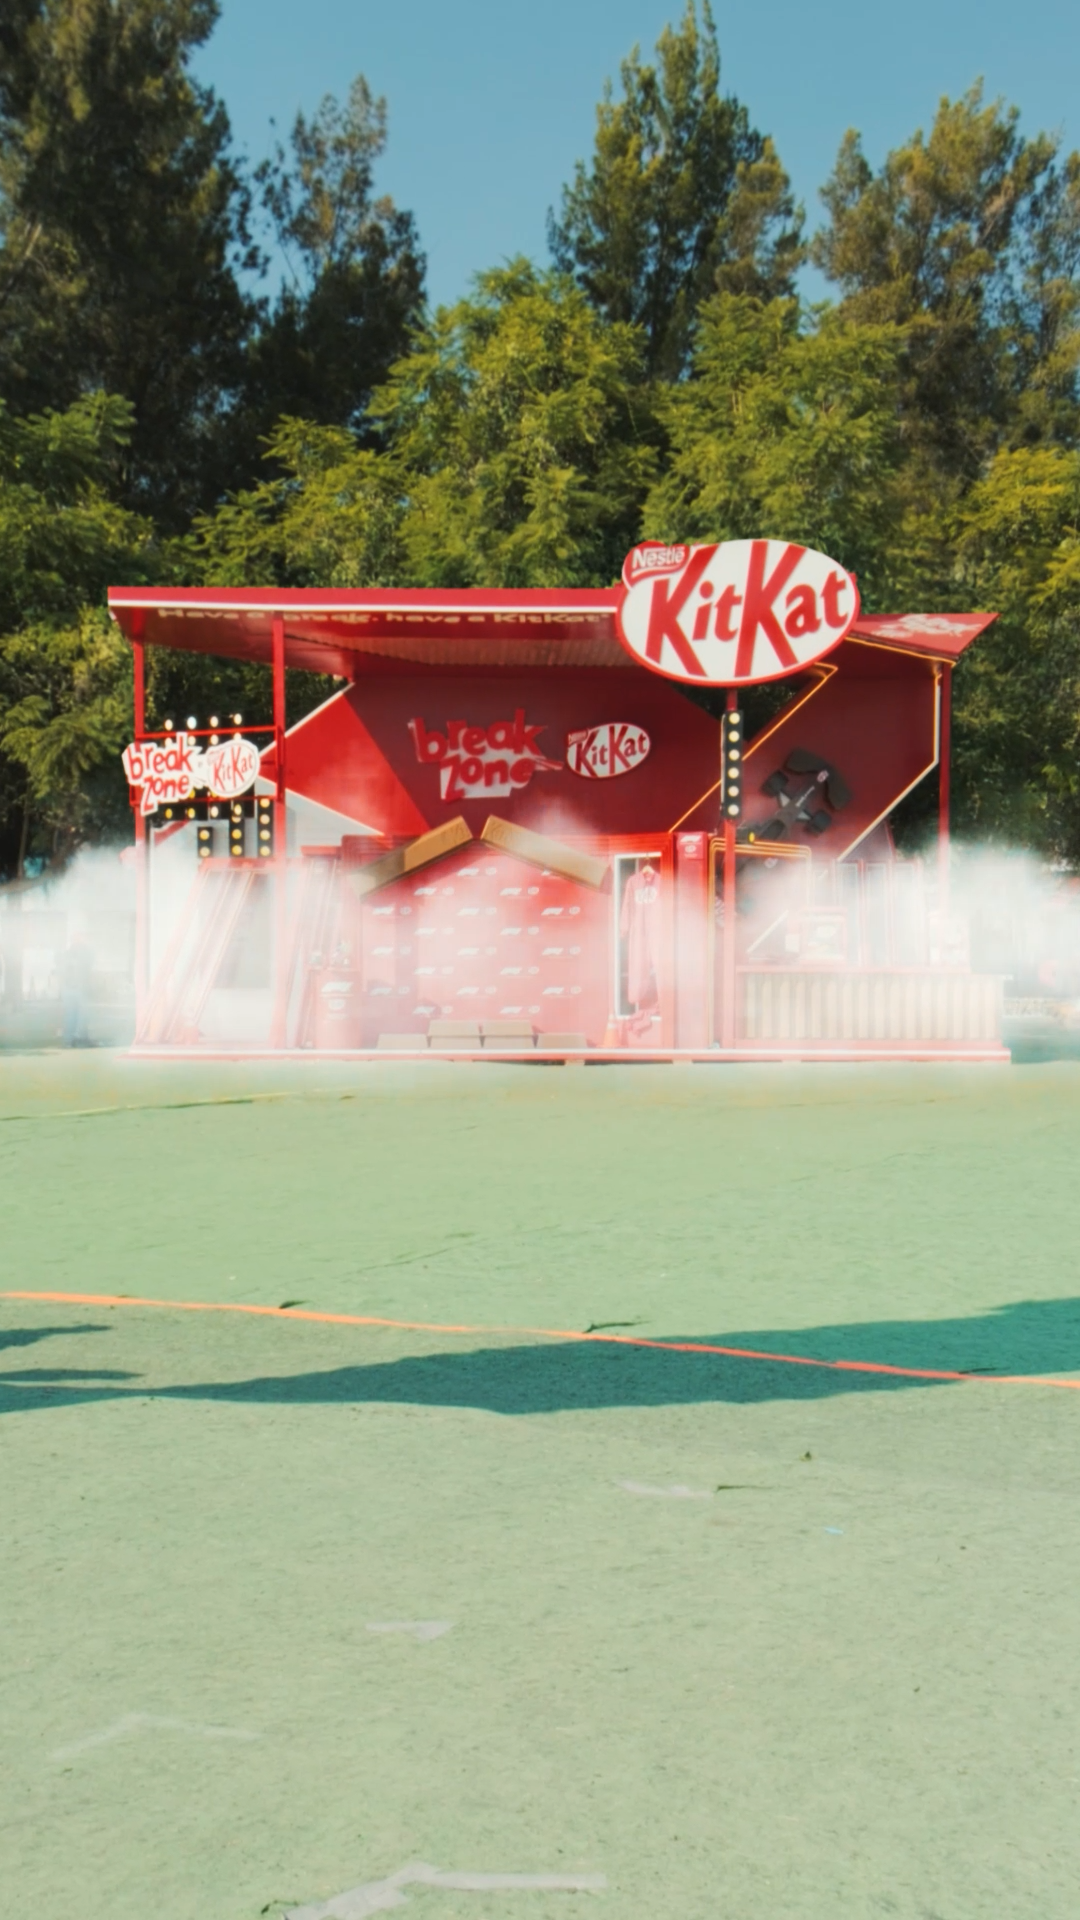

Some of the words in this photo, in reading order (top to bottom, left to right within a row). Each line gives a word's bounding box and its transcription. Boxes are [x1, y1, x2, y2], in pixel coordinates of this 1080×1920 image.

[157, 608, 239, 619] Have
[246, 611, 265, 619] a
[386, 612, 460, 623] have
[467, 614, 486, 622] a
[645, 540, 848, 678] KitKat
[126, 735, 194, 780] break
[408, 708, 546, 763] break
[575, 724, 647, 778] KitKat
[213, 745, 253, 791] KitKat
